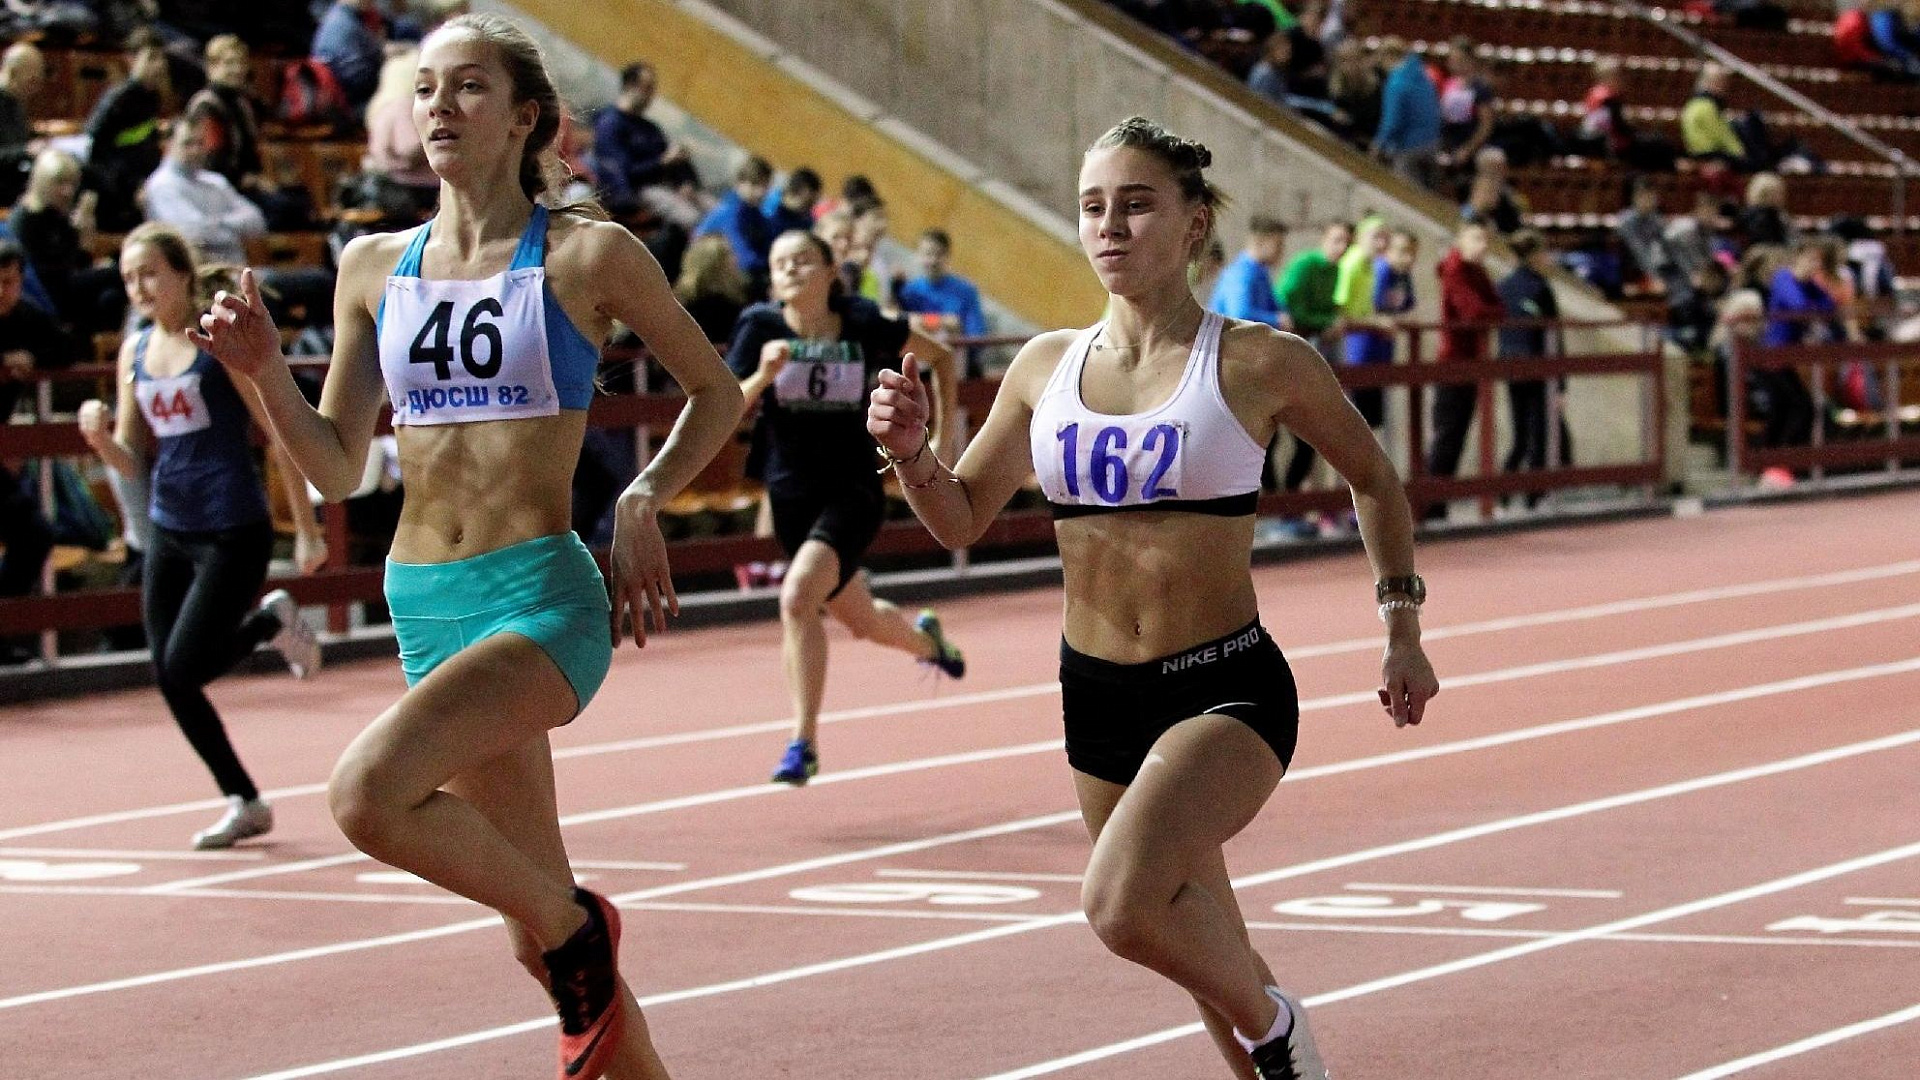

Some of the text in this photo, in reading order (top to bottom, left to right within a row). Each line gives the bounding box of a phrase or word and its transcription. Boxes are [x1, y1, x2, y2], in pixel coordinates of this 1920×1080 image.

[409, 297, 503, 380] 46
[808, 363, 828, 399] 6
[152, 386, 194, 422] 44
[407, 385, 530, 414] ДЮСШ 82
[1056, 422, 1180, 504] 162
[1162, 627, 1260, 674] NIKE PRO
[1271, 895, 1548, 922] 5
